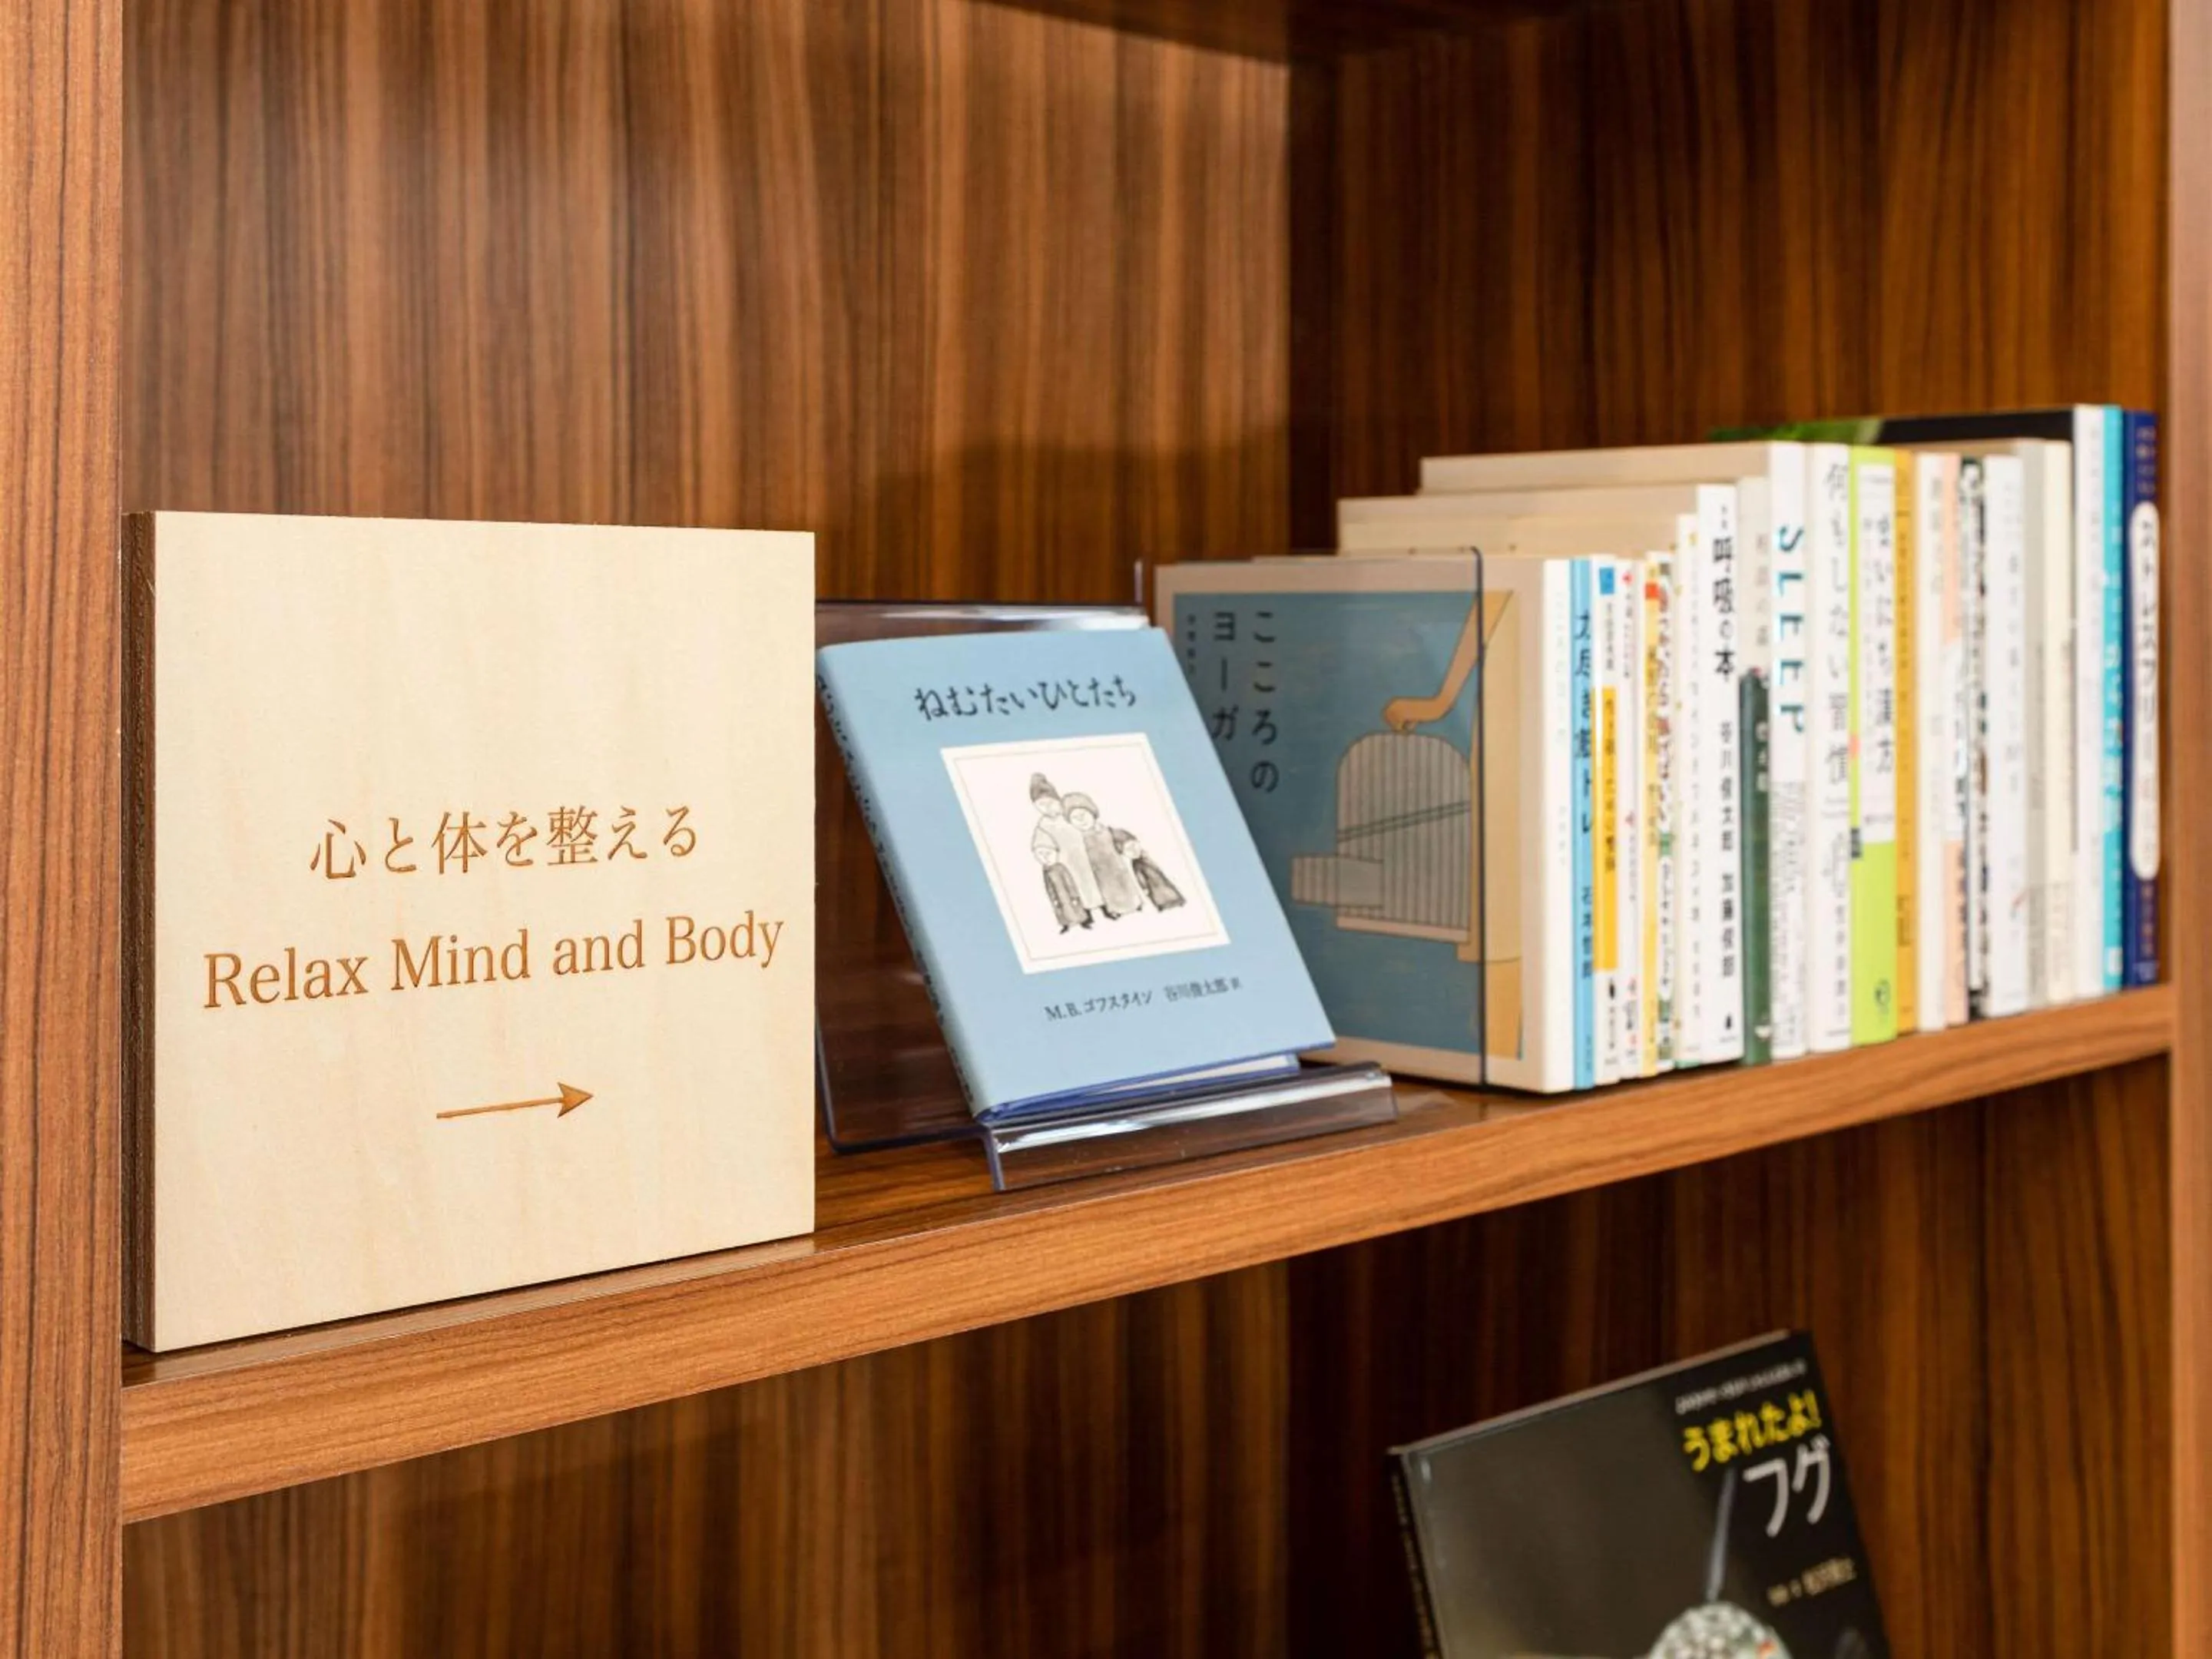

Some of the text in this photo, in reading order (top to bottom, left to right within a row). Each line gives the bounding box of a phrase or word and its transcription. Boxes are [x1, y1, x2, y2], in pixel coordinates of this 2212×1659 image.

[1213, 611, 1239, 742] ヨーガ
[1777, 524, 1805, 733] SLEEP
[914, 674, 1136, 721] ねむたいひとたち
[1250, 611, 1280, 794] こころの
[310, 804, 698, 880] 心と体を整える
[204, 910, 783, 1009] Relax Mind and Body
[1683, 1388, 1823, 1472] うまれたよ!
[1742, 1432, 1831, 1538] フグ
